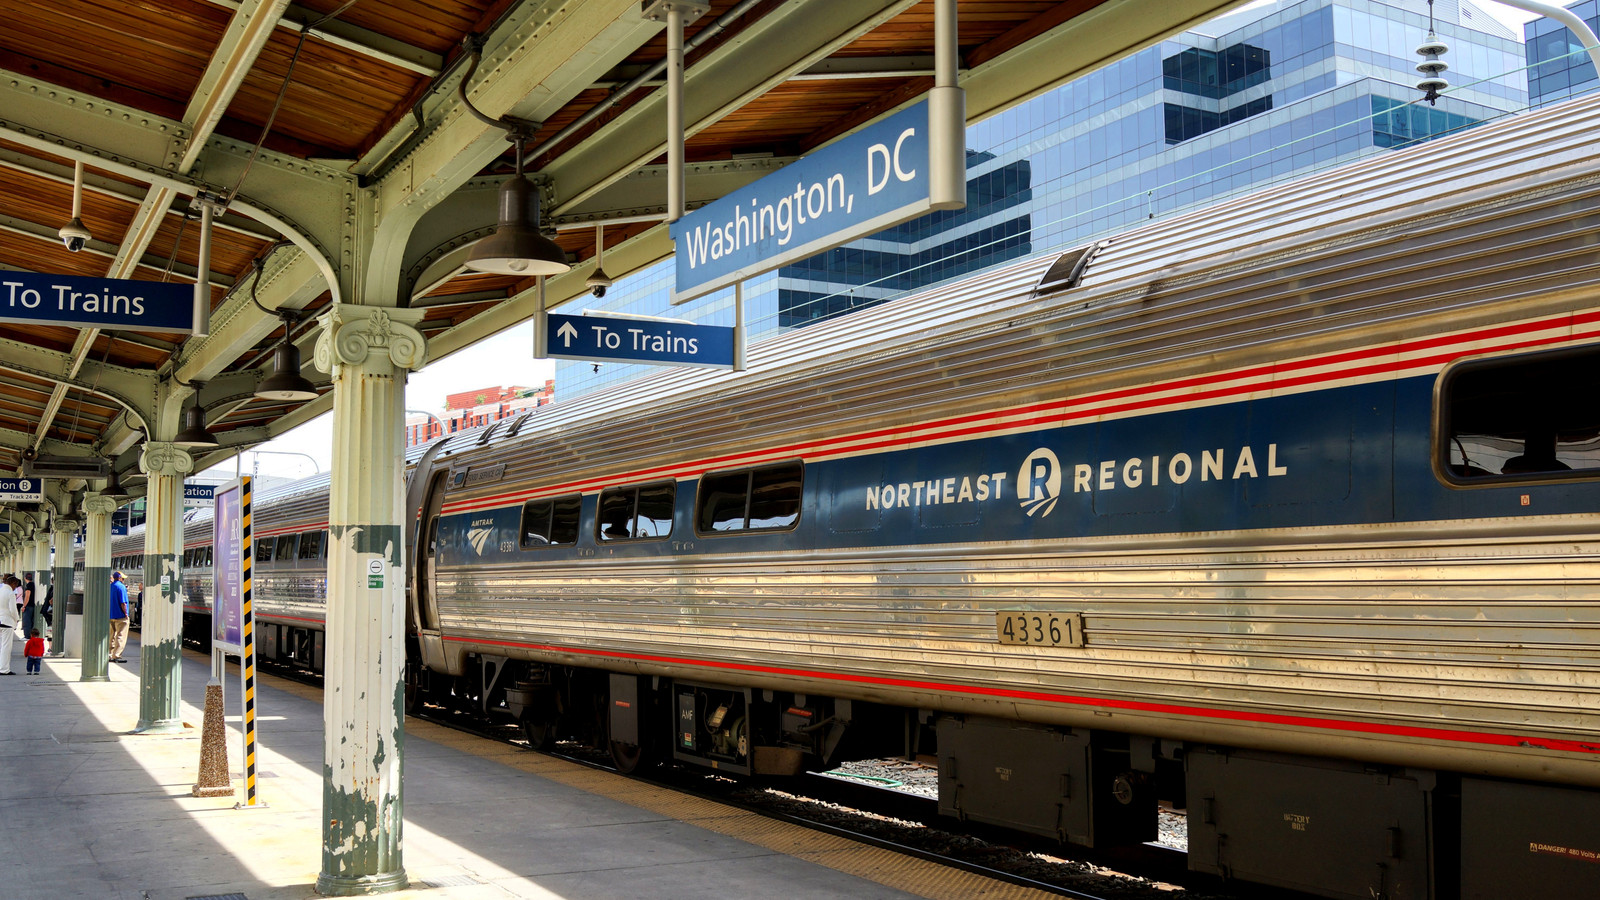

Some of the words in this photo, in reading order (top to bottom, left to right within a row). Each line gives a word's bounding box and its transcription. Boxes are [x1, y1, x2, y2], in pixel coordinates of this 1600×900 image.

[686, 173, 854, 269] Washington,
[867, 128, 916, 196] DC
[2, 281, 41, 309] To
[51, 284, 145, 316] Trains
[591, 326, 621, 350] To
[628, 328, 699, 355] Trains
[22, 481, 28, 489] B
[866, 471, 1006, 511] NORTHEAST
[1074, 443, 1288, 493] REGIONAL
[471, 518, 494, 527] AMTRAK
[1002, 616, 1074, 644] 43361
[1538, 843, 1566, 853] DANGER!
[1580, 850, 1596, 859] Volts
